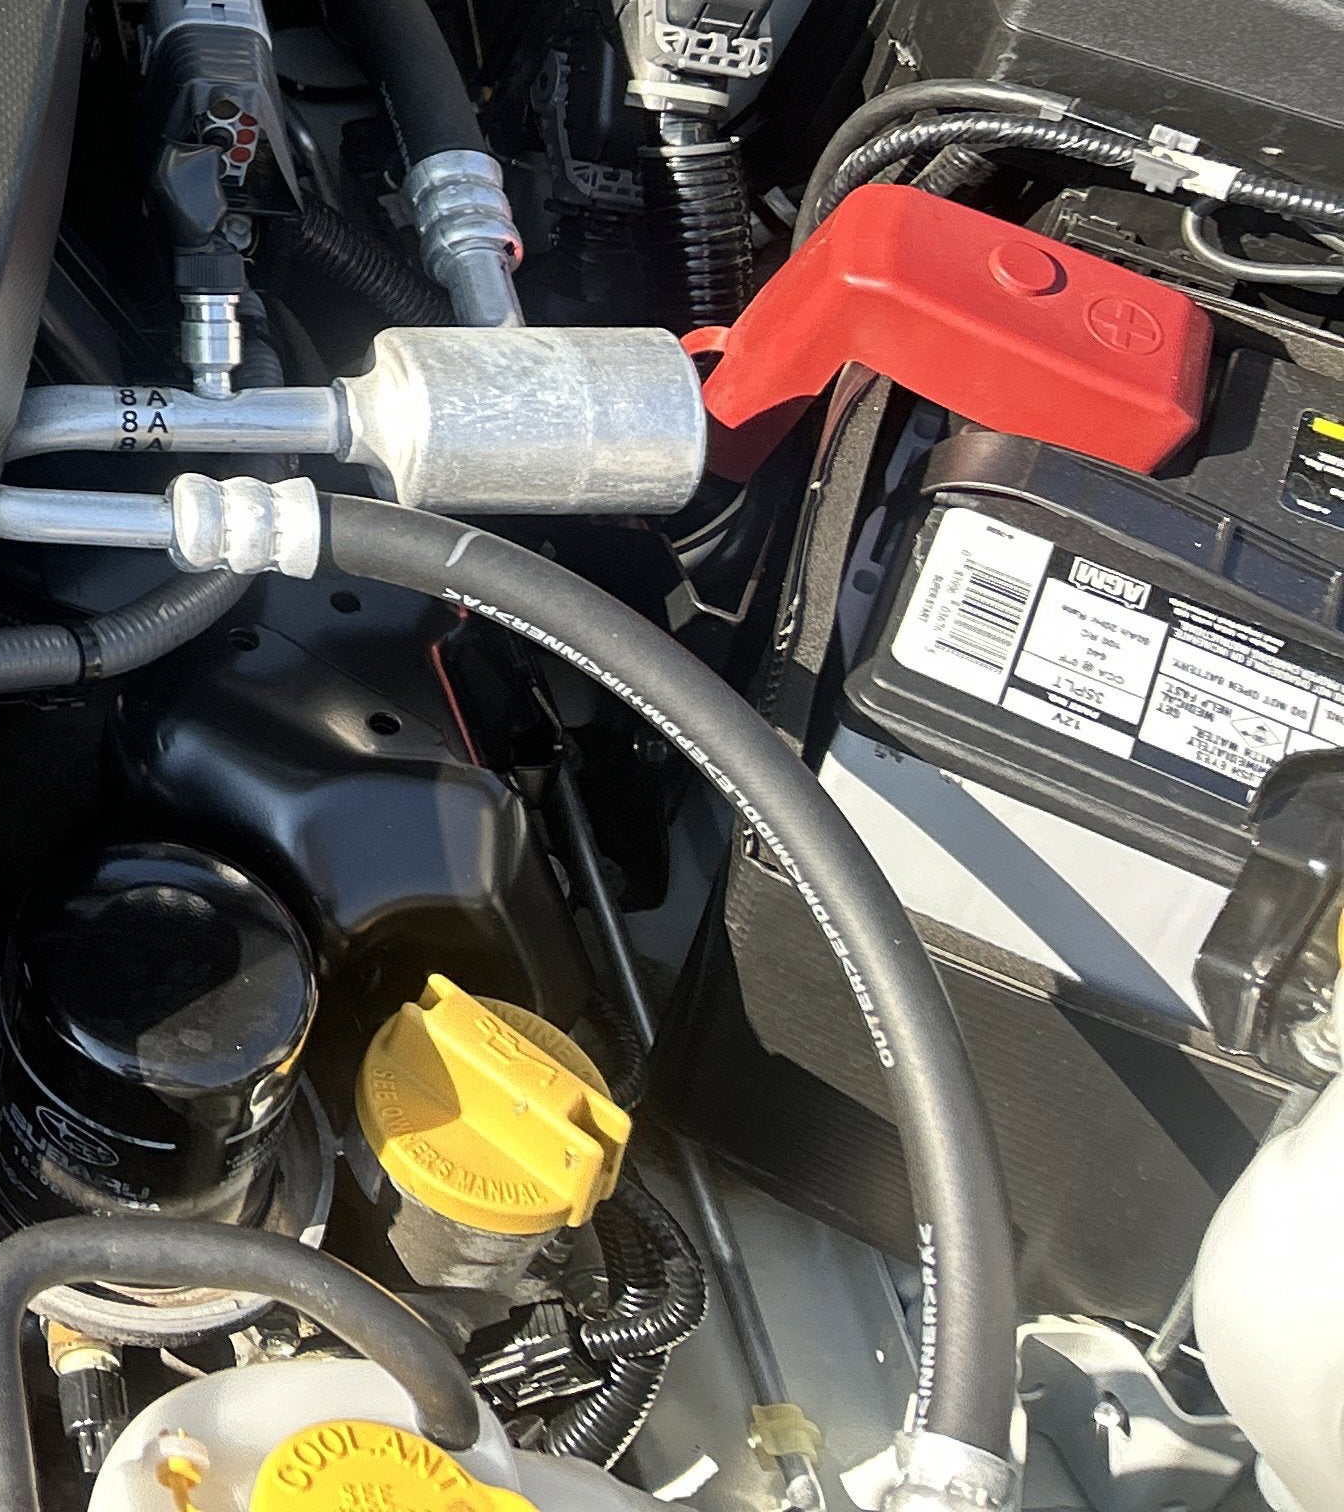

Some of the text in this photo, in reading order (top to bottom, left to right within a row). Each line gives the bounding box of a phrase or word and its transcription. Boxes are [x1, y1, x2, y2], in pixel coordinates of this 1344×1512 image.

[119, 388, 167, 406] 8 A
[121, 409, 168, 433] 8 A
[1074, 561, 1145, 604] AGM
[371, 1066, 395, 1100] SEE
[453, 1169, 548, 1206] MANUAL
[276, 1422, 470, 1493] COOLANT
